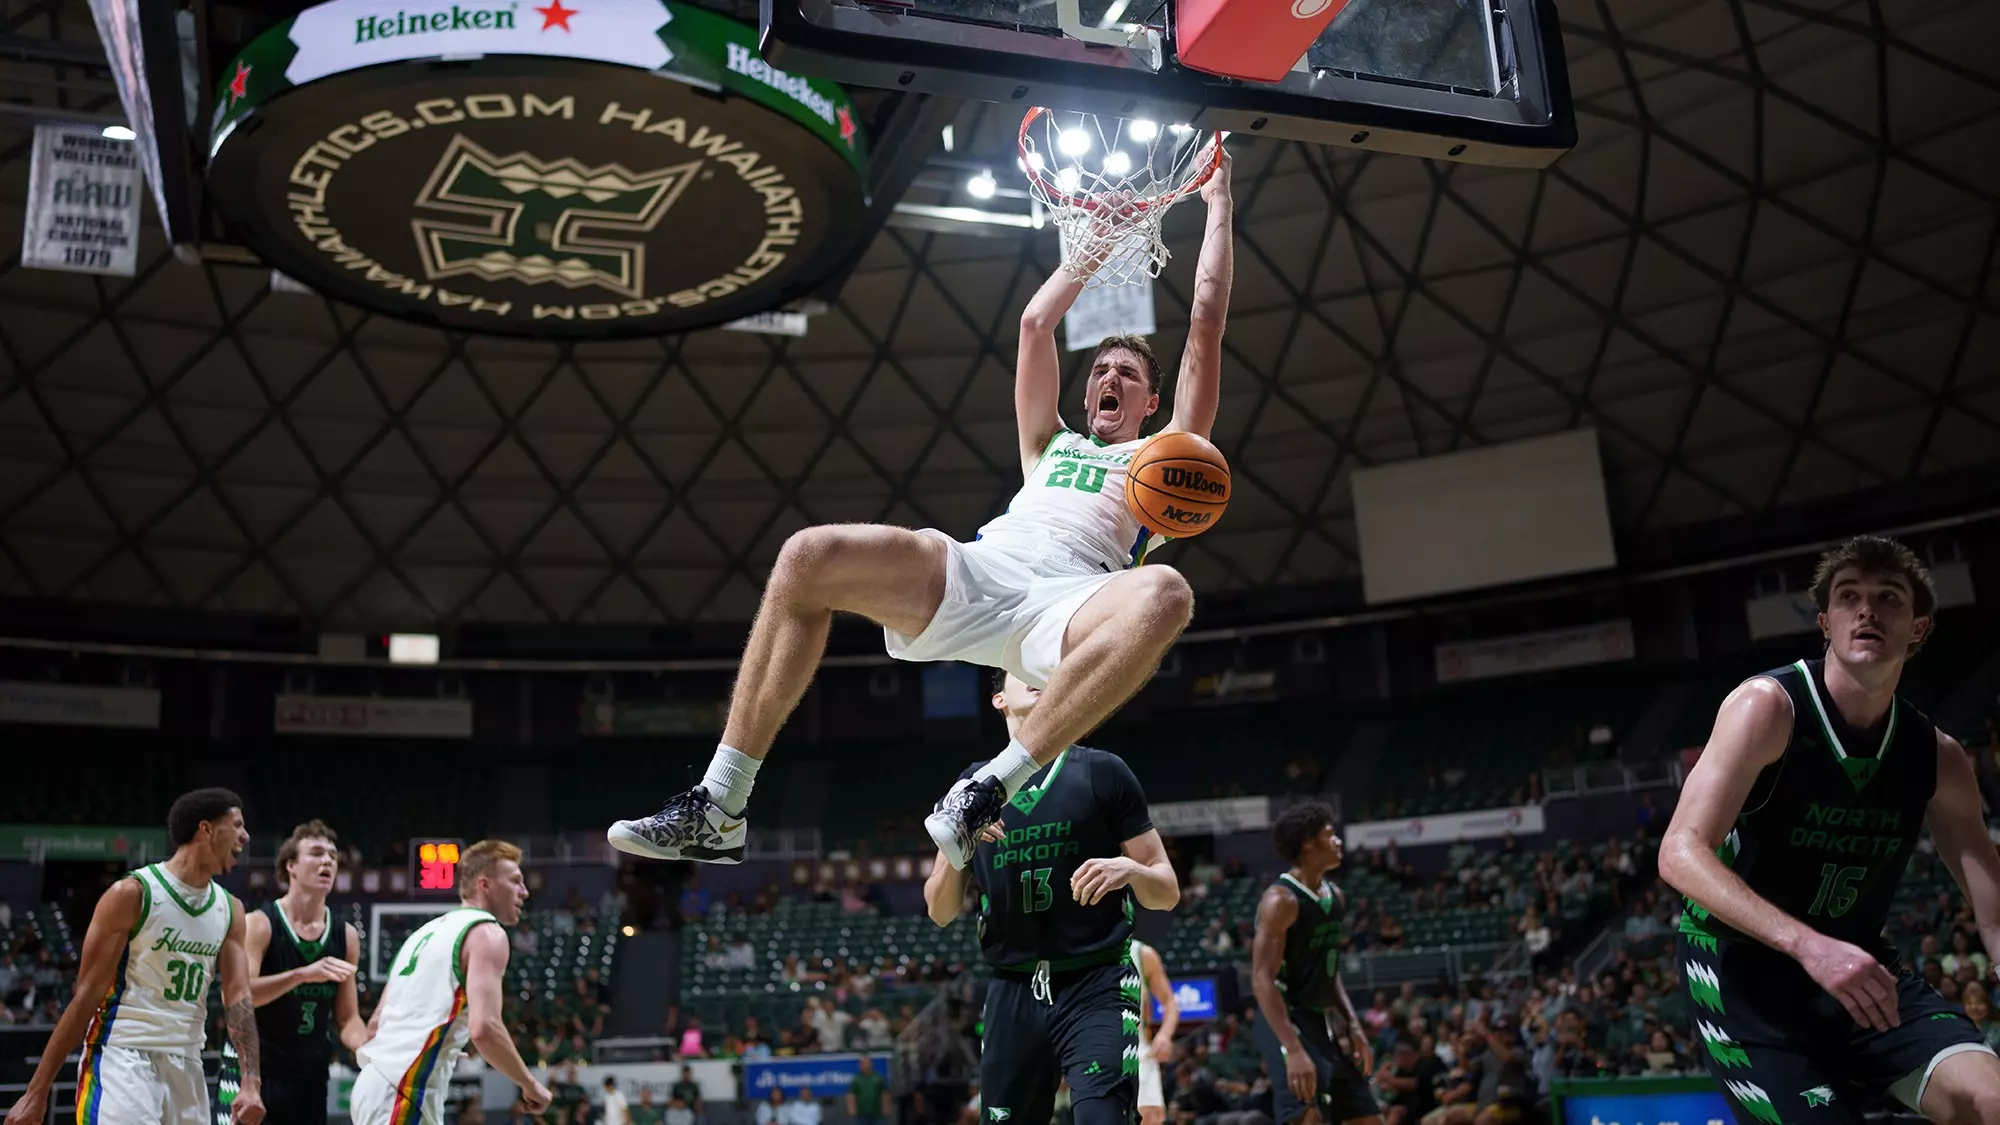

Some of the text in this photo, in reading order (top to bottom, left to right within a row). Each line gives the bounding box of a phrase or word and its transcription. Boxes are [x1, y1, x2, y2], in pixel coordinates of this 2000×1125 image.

[354, 5, 516, 44] Heineken
[726, 42, 835, 125] Heineken
[56, 215, 124, 231] NATIONAL
[48, 230, 128, 247] CHAMPION
[65, 247, 111, 268] 1979
[1045, 460, 1108, 494] 20
[1162, 466, 1226, 497] Wilson
[1161, 504, 1213, 524] NCAA
[1804, 802, 1902, 830] NORTH
[996, 821, 1072, 848] NORTH
[1789, 826, 1903, 856] DAKOTA
[993, 840, 1080, 870] DAKOTA
[1020, 867, 1053, 914] 13
[1807, 862, 1867, 918] 16
[163, 959, 204, 1002] 30
[297, 1001, 317, 1034] 3
